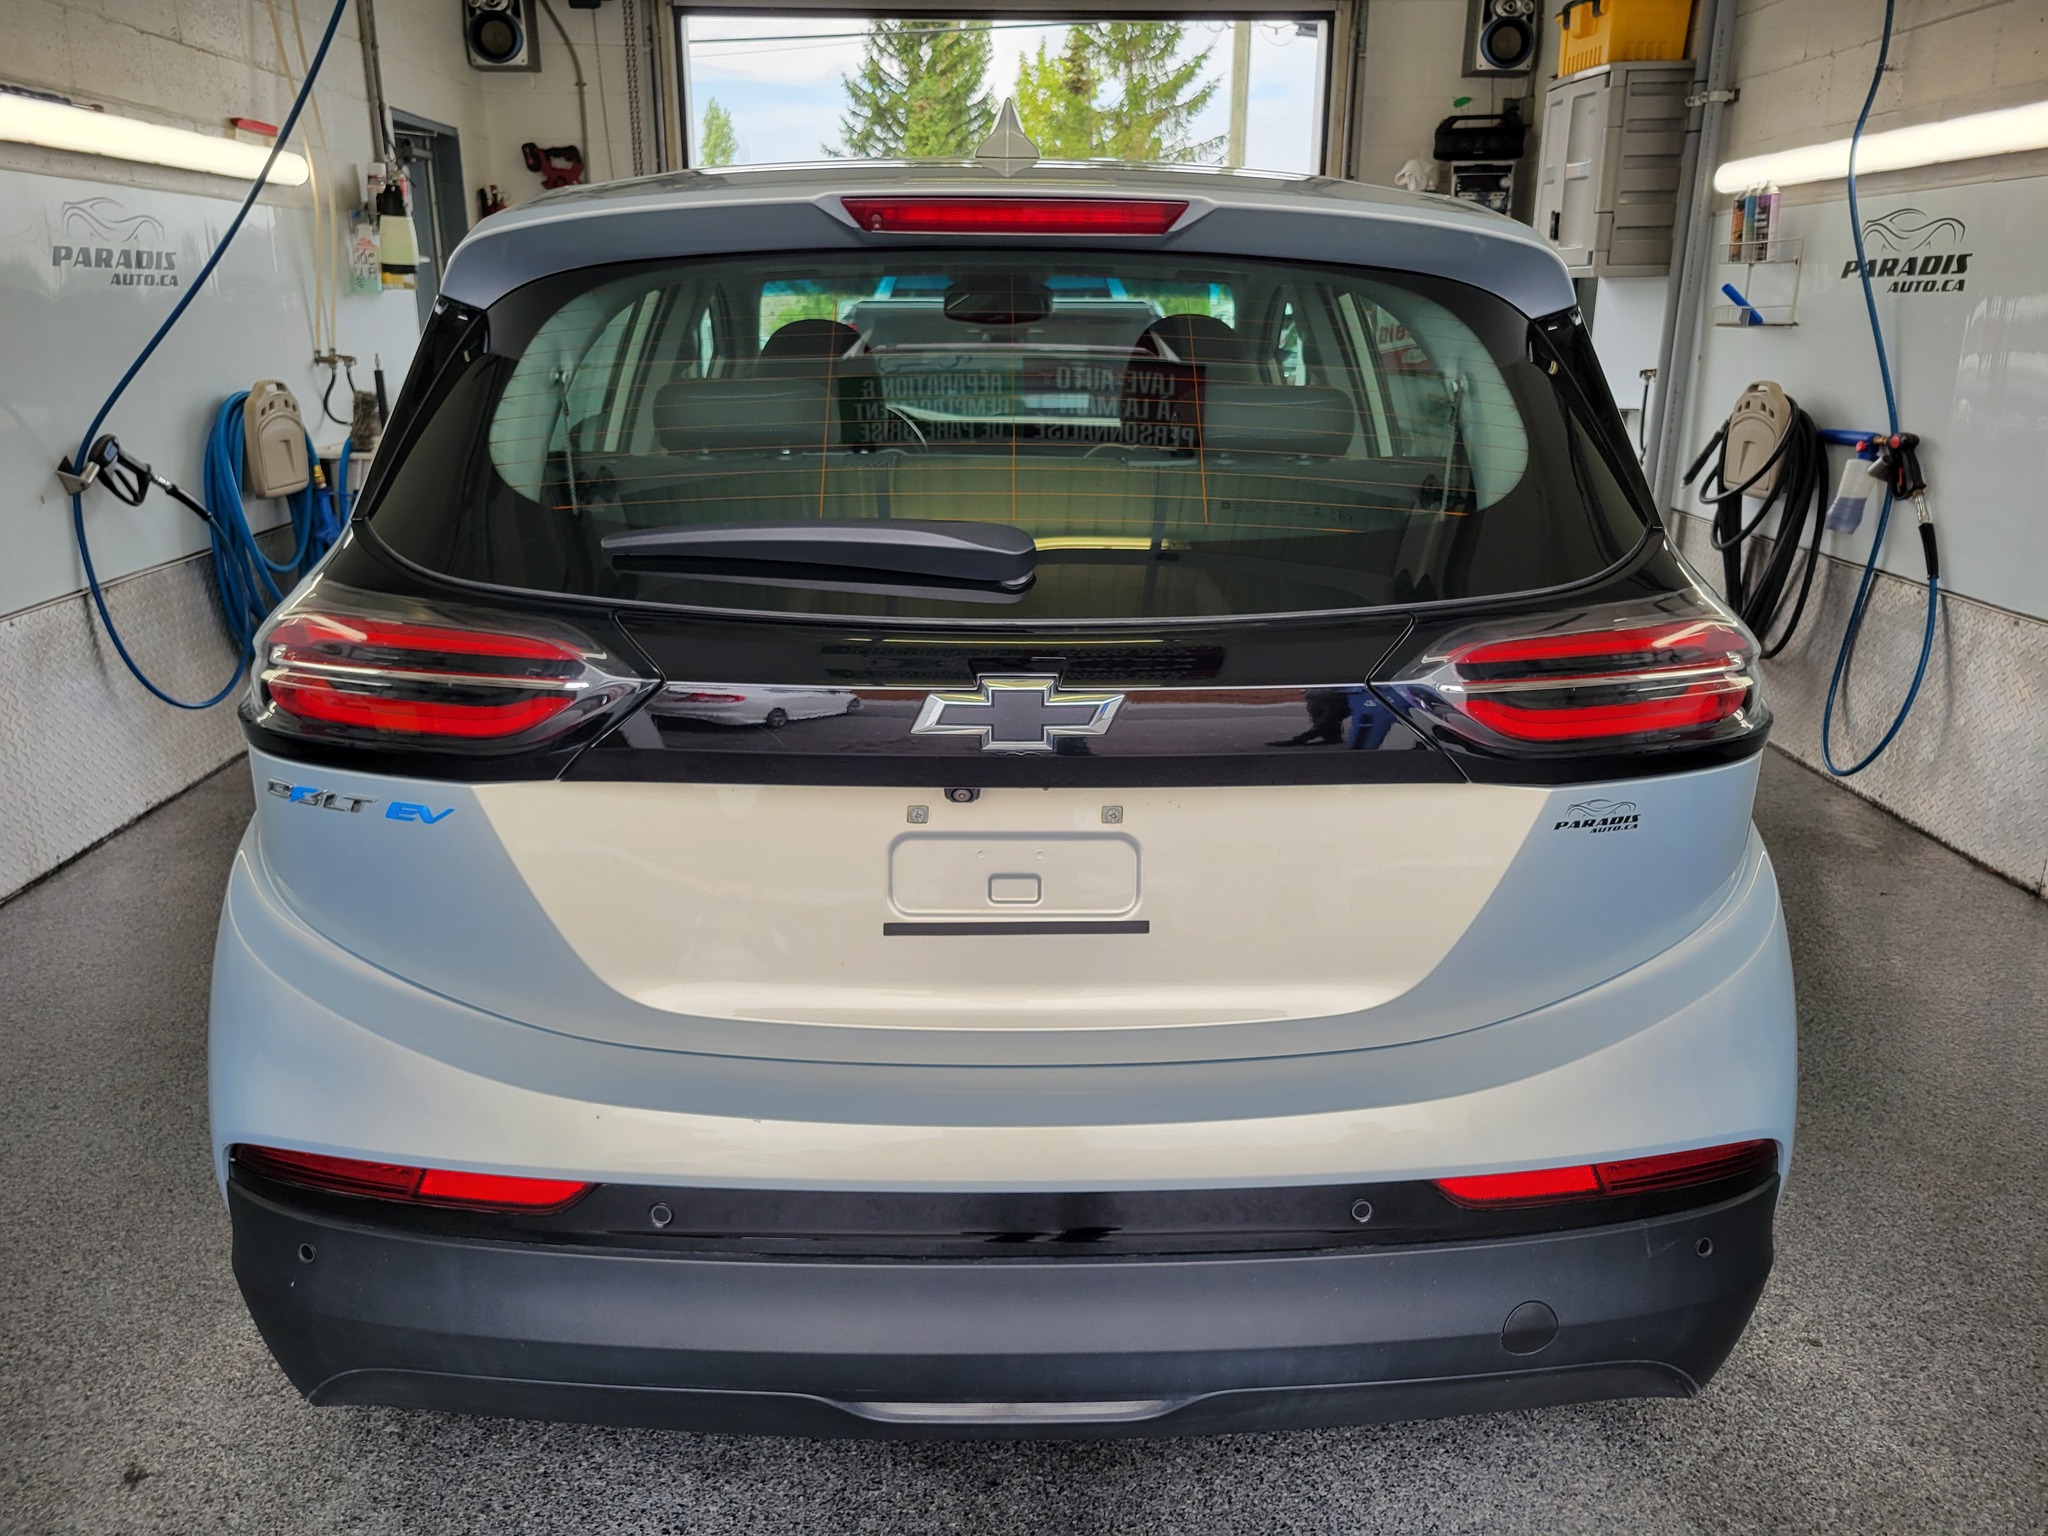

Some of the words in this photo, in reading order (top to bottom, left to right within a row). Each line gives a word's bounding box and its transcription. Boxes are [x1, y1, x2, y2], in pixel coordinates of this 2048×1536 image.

[52, 246, 177, 270] PARADIS
[1840, 253, 1974, 279] PARADIS
[110, 273, 179, 287] AUTO.CA
[1887, 279, 1966, 293] AUTO.CA
[267, 776, 378, 813] BOLT
[385, 801, 456, 825] EV
[1554, 814, 1642, 830] PARADIS
[1589, 823, 1639, 834] AUTO.CA
